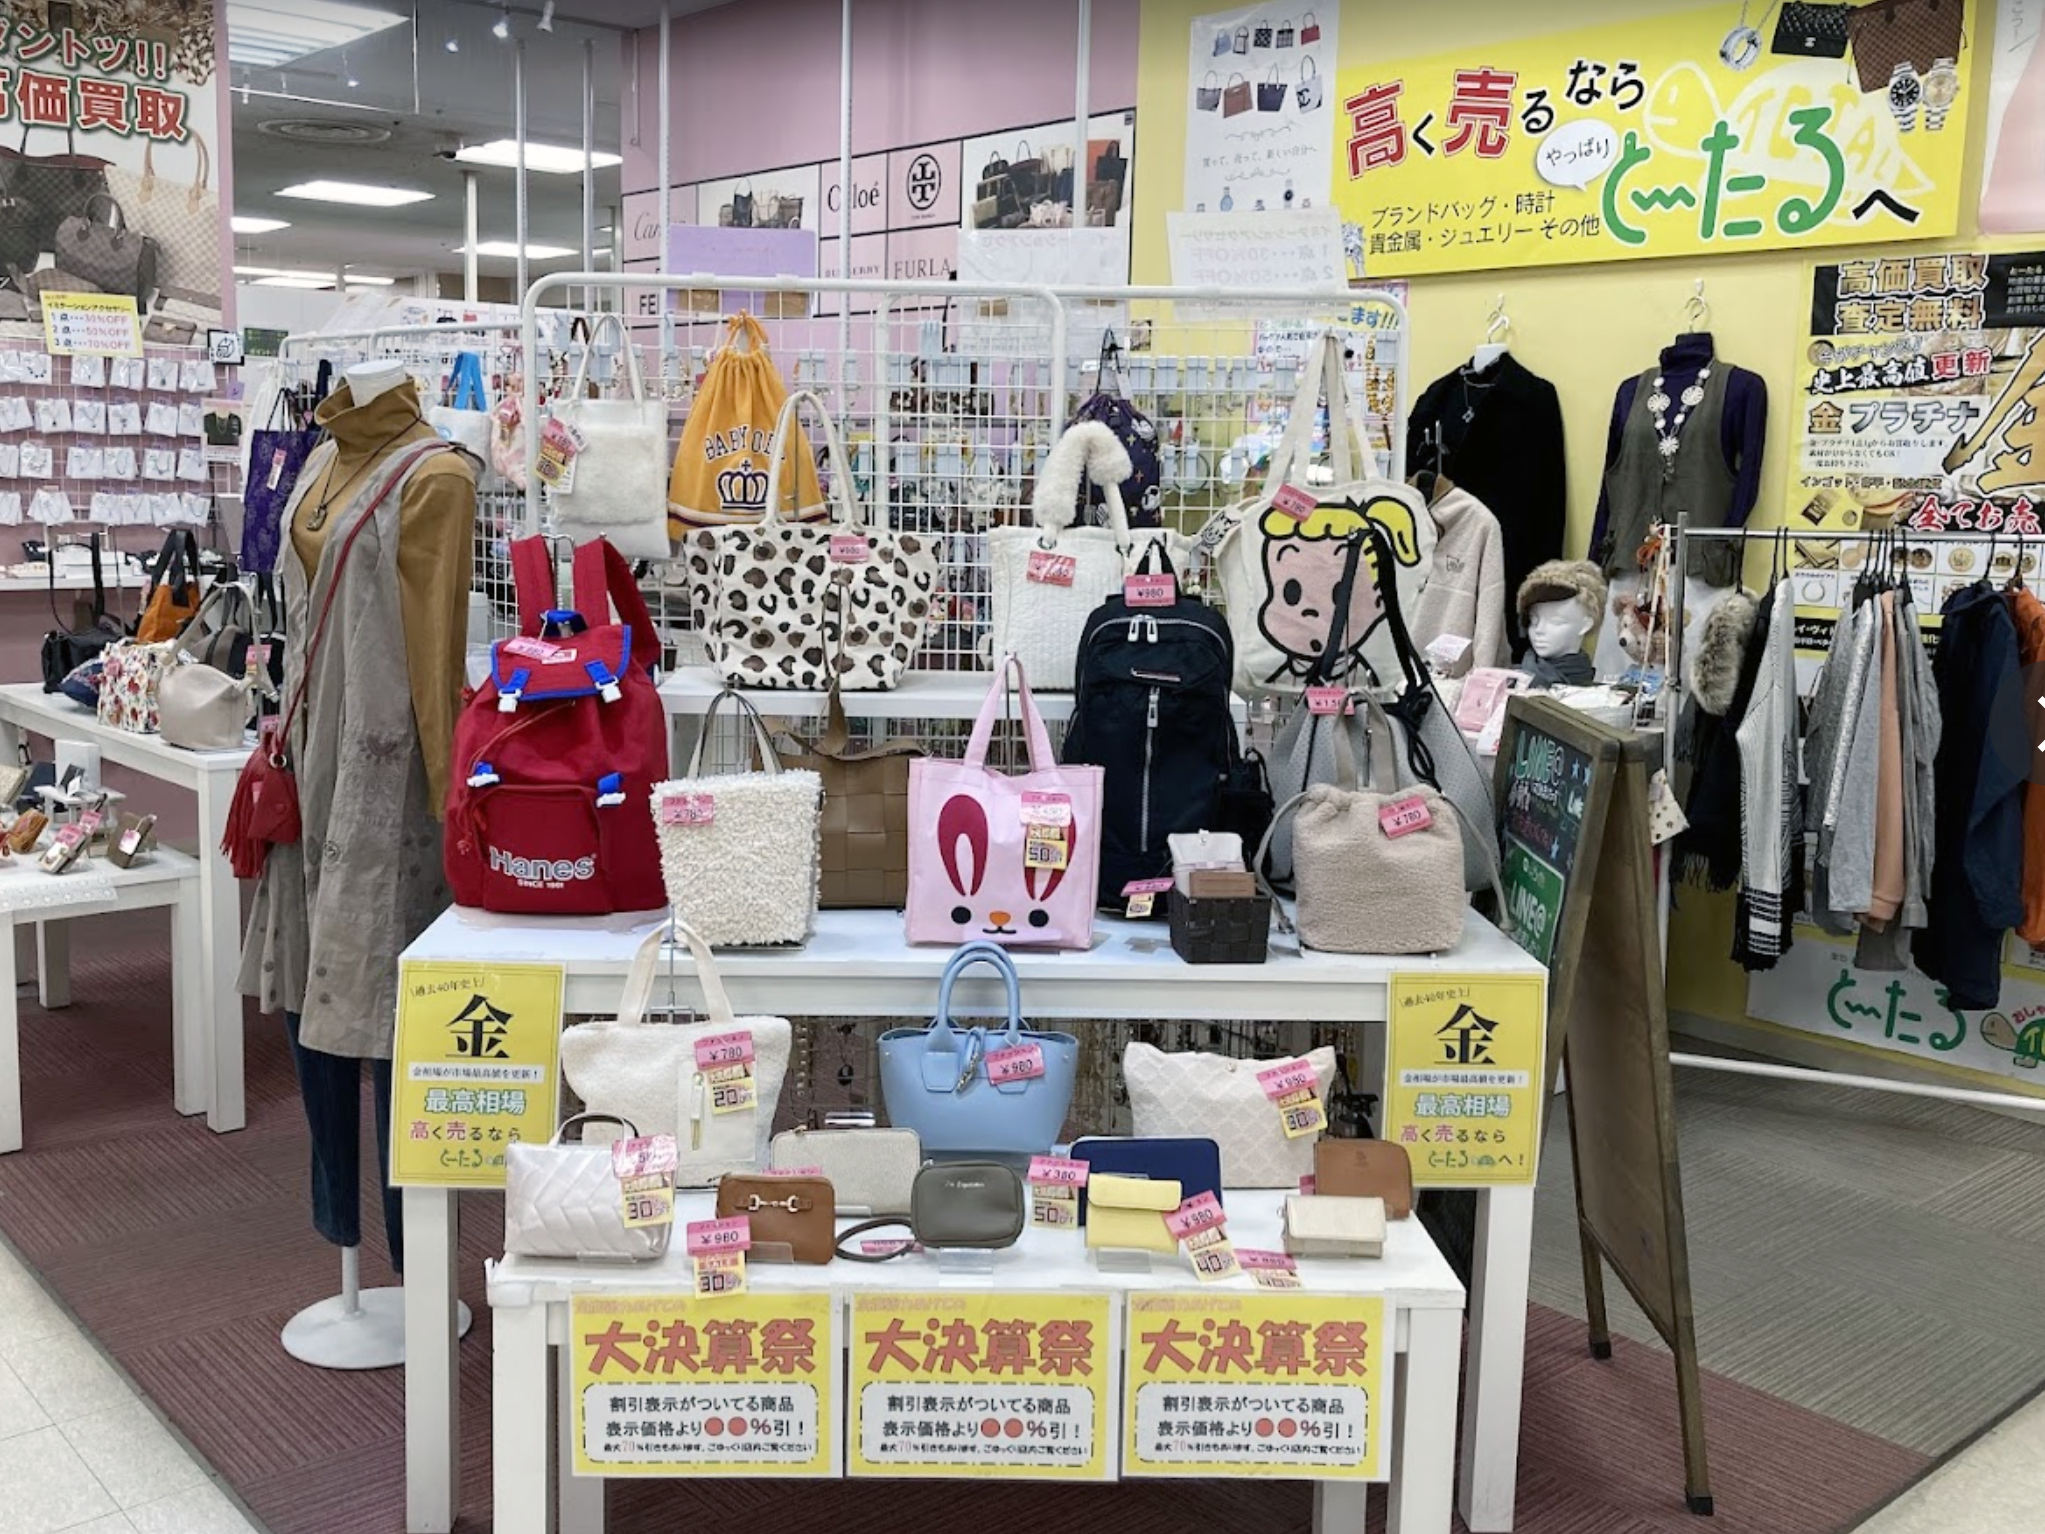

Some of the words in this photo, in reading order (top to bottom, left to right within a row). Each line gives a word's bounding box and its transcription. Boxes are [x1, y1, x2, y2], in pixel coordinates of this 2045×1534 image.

[0, 71, 187, 139] 価買取
[1343, 59, 1646, 180] 高く売るなら
[1545, 136, 1611, 166] やっぱり
[826, 174, 879, 224] Cloé
[1371, 191, 1556, 224] ブランドバッグ・時計
[1369, 221, 1534, 256] 貴金属・ジュエリー
[1540, 213, 1601, 238] その他
[894, 259, 950, 284] FURLA
[1839, 254, 1988, 296] 高価買取
[1836, 296, 1985, 334] 査定無料
[1808, 401, 1844, 434] 金
[1850, 401, 1980, 434] プラチナ
[1136, 586, 1165, 599] ¥980
[489, 845, 595, 882] Hanes
[1511, 880, 1547, 938] LINE@
[445, 994, 514, 1058] 金
[1434, 1004, 1499, 1064] 金
[709, 1046, 742, 1060] ¥780
[1000, 1058, 1033, 1075] ¥980
[424, 1088, 526, 1115] 最高相場
[1414, 1093, 1512, 1118] 最高相場
[410, 1120, 521, 1143] 高く売るなら
[1401, 1124, 1506, 1143] 高く売るなら
[1043, 1169, 1076, 1180] ¥380
[1180, 1208, 1213, 1228] ¥980
[701, 1231, 738, 1244] ¥980
[585, 1318, 816, 1376] 大決算祭
[865, 1318, 1094, 1376] 大決算祭
[1141, 1318, 1368, 1376] 大決算祭
[609, 1396, 794, 1413] 割引表示がついてる商品
[887, 1395, 1071, 1414] 割引表示がついてる商品
[1162, 1396, 1344, 1414] 割引表示がついてる商品
